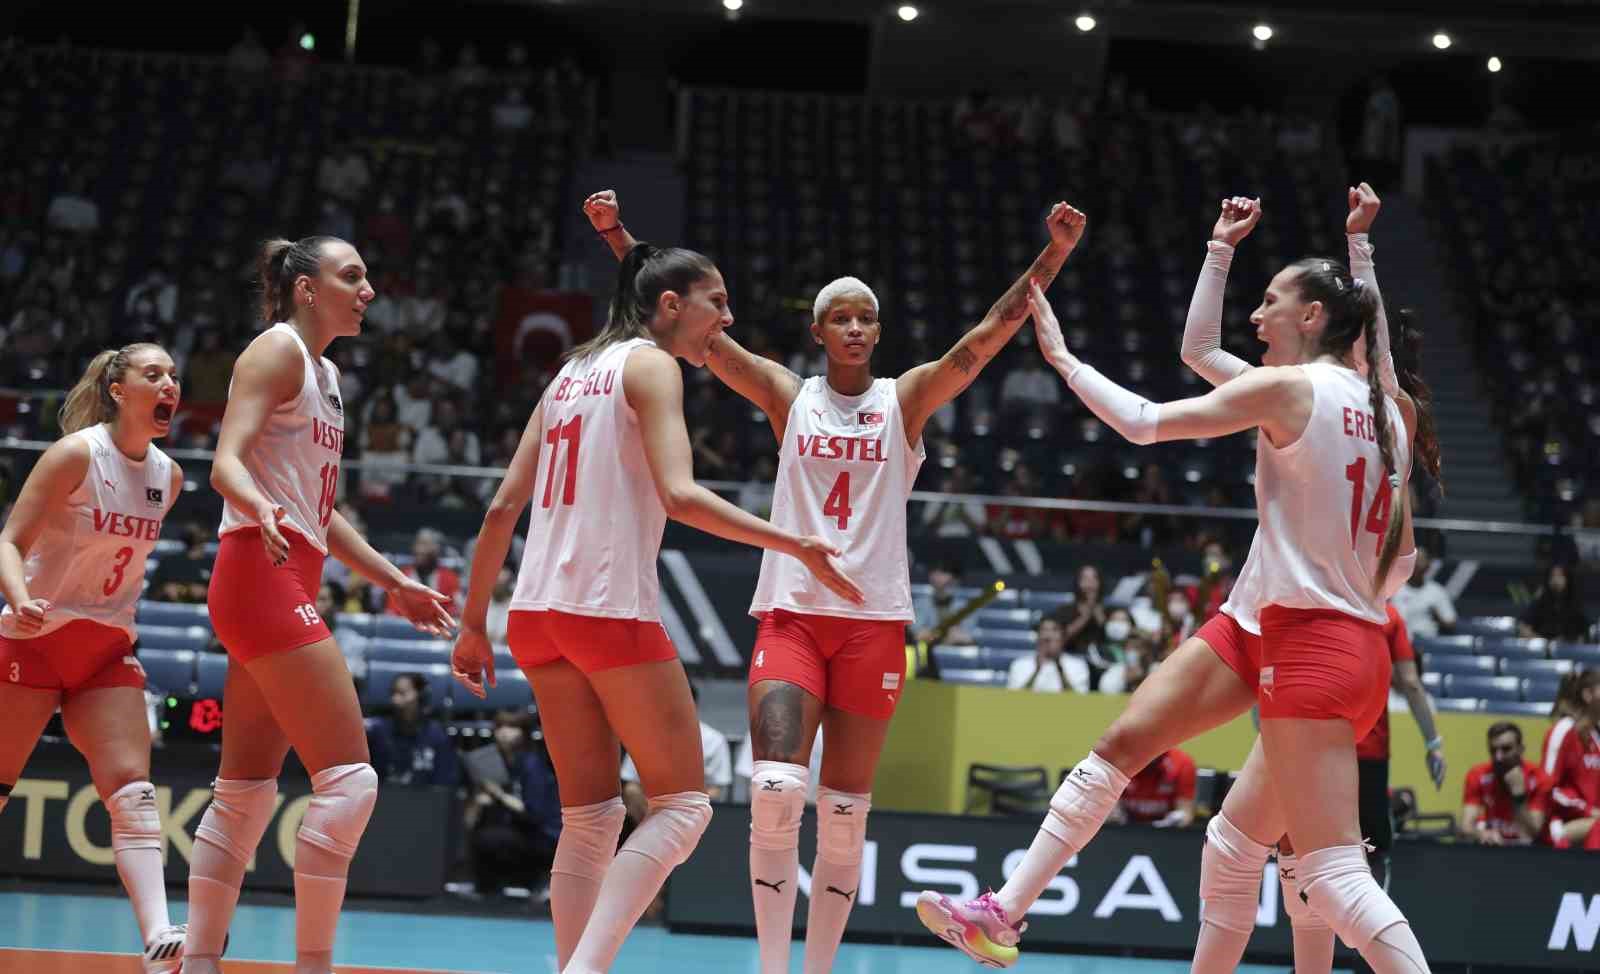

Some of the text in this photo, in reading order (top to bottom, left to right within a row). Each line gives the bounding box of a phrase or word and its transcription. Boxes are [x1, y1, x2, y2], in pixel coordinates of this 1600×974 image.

[543, 415, 582, 508] 11
[797, 434, 888, 462] VESTEL
[319, 461, 337, 528] 19
[823, 471, 852, 530] 4
[1346, 457, 1392, 558] 14
[103, 546, 134, 596] 3
[294, 604, 320, 626] 19
[9, 662, 20, 682] 3
[754, 650, 765, 668] 4
[9, 779, 315, 872] TOK
